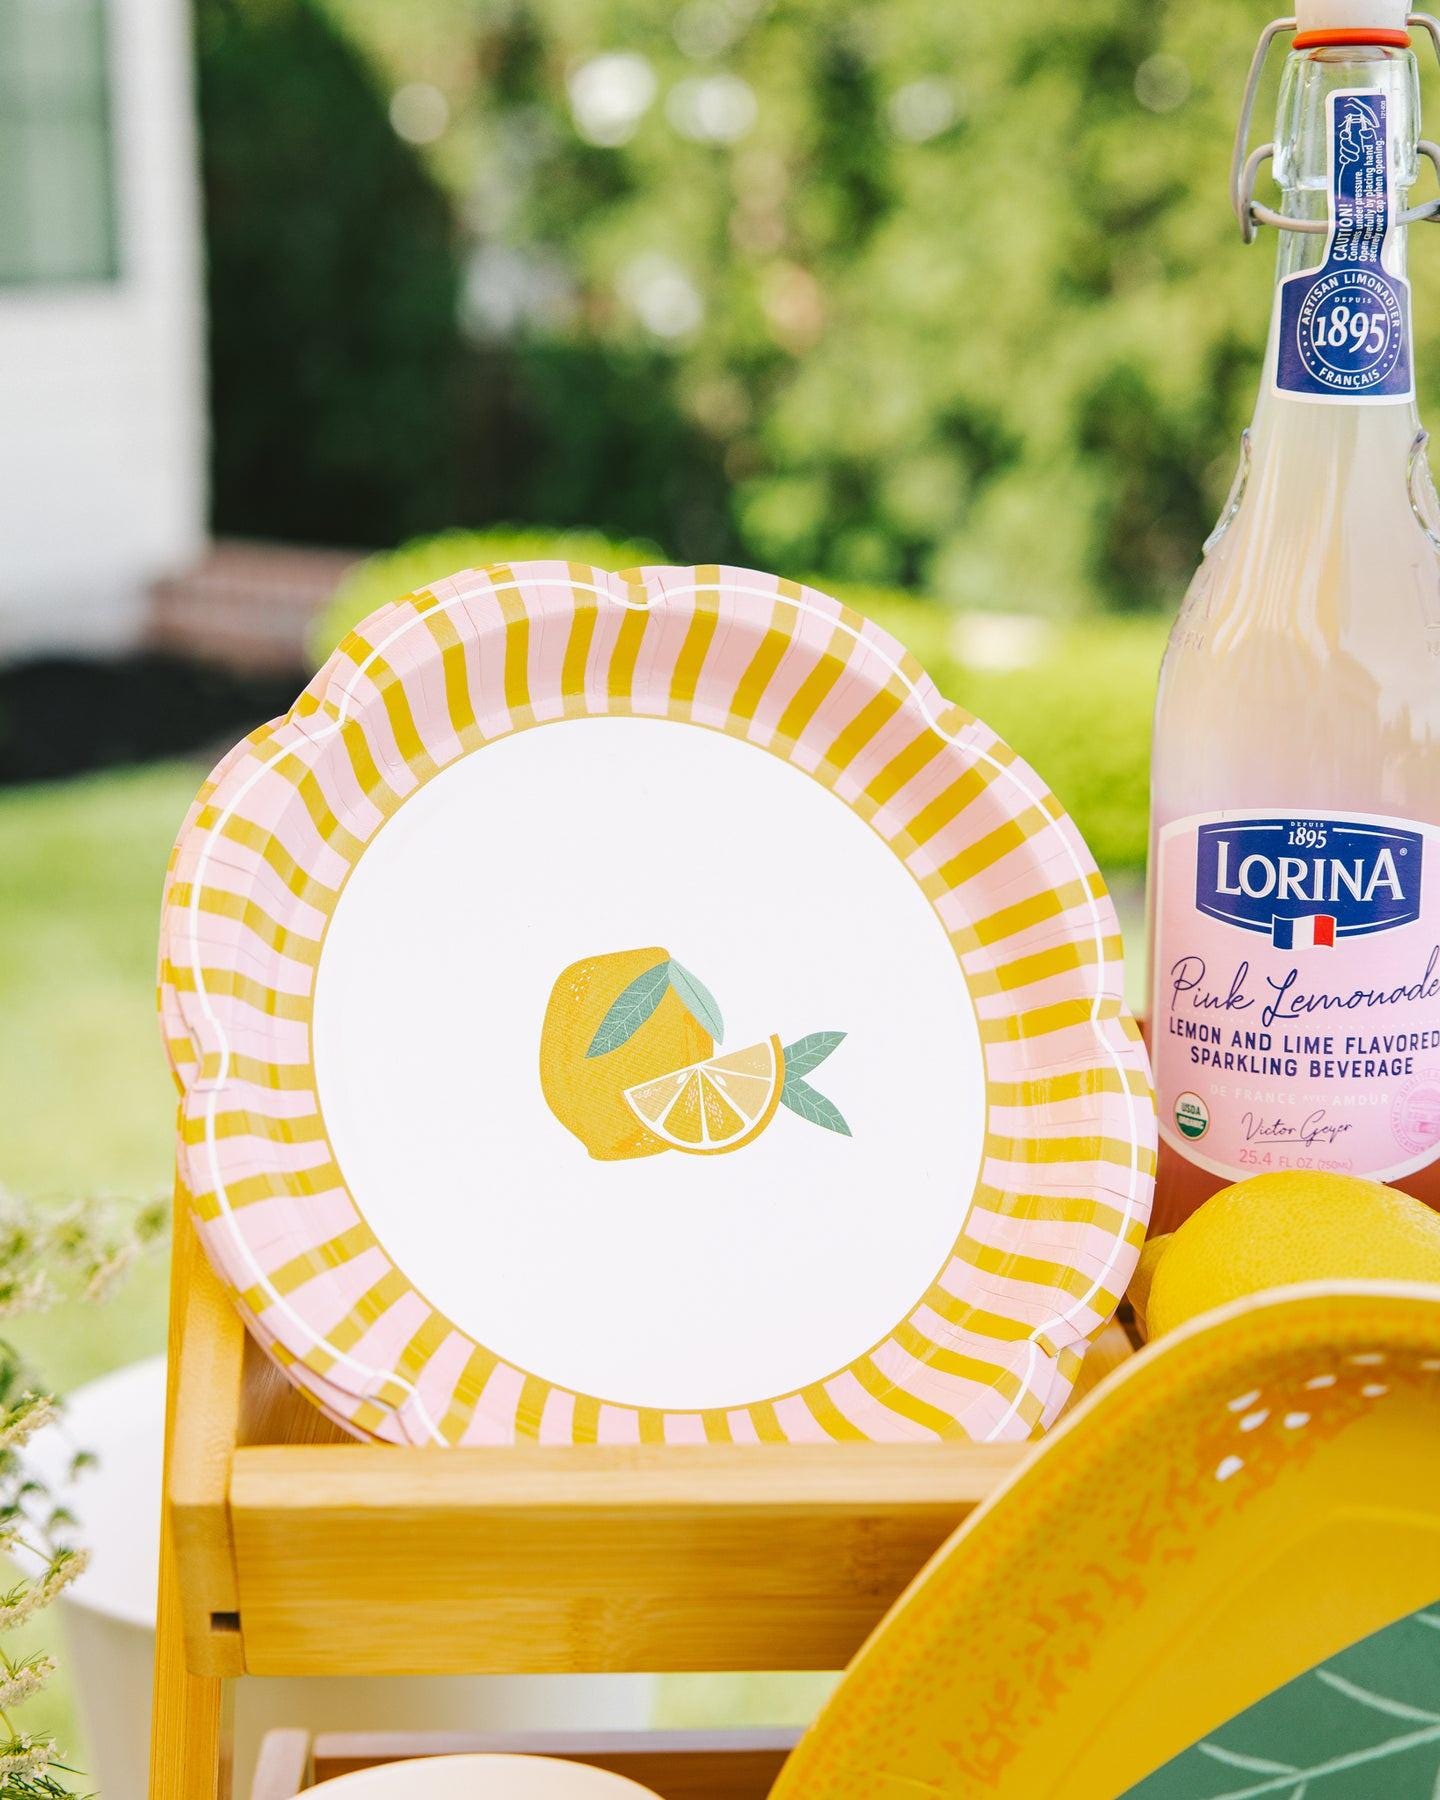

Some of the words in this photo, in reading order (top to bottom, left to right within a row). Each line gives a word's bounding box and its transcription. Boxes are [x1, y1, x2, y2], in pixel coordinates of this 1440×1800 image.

[1364, 144, 1373, 166] hand
[1375, 137, 1386, 174] opening.
[1354, 169, 1364, 205] pressure.
[1364, 167, 1375, 197] placing
[1374, 176, 1384, 198] when
[1363, 198, 1374, 208] by
[1376, 199, 1386, 213] cap
[1354, 206, 1363, 230] under
[1362, 209, 1374, 240] carefully
[1376, 214, 1384, 232] over
[1333, 203, 1353, 261] CAUTION!
[1348, 231, 1362, 261] Contents
[1359, 240, 1370, 261] Open
[1369, 233, 1384, 263] securely
[1302, 276, 1339, 325] ARTISAN
[1344, 273, 1400, 327] LIMONADIER
[1334, 296, 1372, 304] DEPUIS
[1314, 306, 1386, 354] 1895
[1318, 368, 1381, 388] FRANÇAIS
[1287, 827, 1327, 849] 1895
[1170, 956, 1255, 1012] Pink
[1261, 945, 1440, 1027] Lemonade
[1170, 1016, 1221, 1045] LEMON
[1231, 1030, 1272, 1051] AND
[1283, 1034, 1334, 1055] LIME
[1345, 1030, 1440, 1055] FLAVORED
[1190, 1045, 1298, 1077] SPARKLING
[1309, 1056, 1414, 1079] BEVERAGE
[1209, 1083, 1227, 1098] DE
[1234, 1087, 1297, 1106] FRANCE
[1331, 1093, 1390, 1106] AMOUR
[1181, 1102, 1201, 1116] USDA
[1241, 1111, 1297, 1141] Victor
[1300, 1109, 1353, 1147] Geyer
[1239, 1149, 1272, 1166] 25.4
[1279, 1156, 1293, 1168] FL
[1297, 1157, 1312, 1169] OZ
